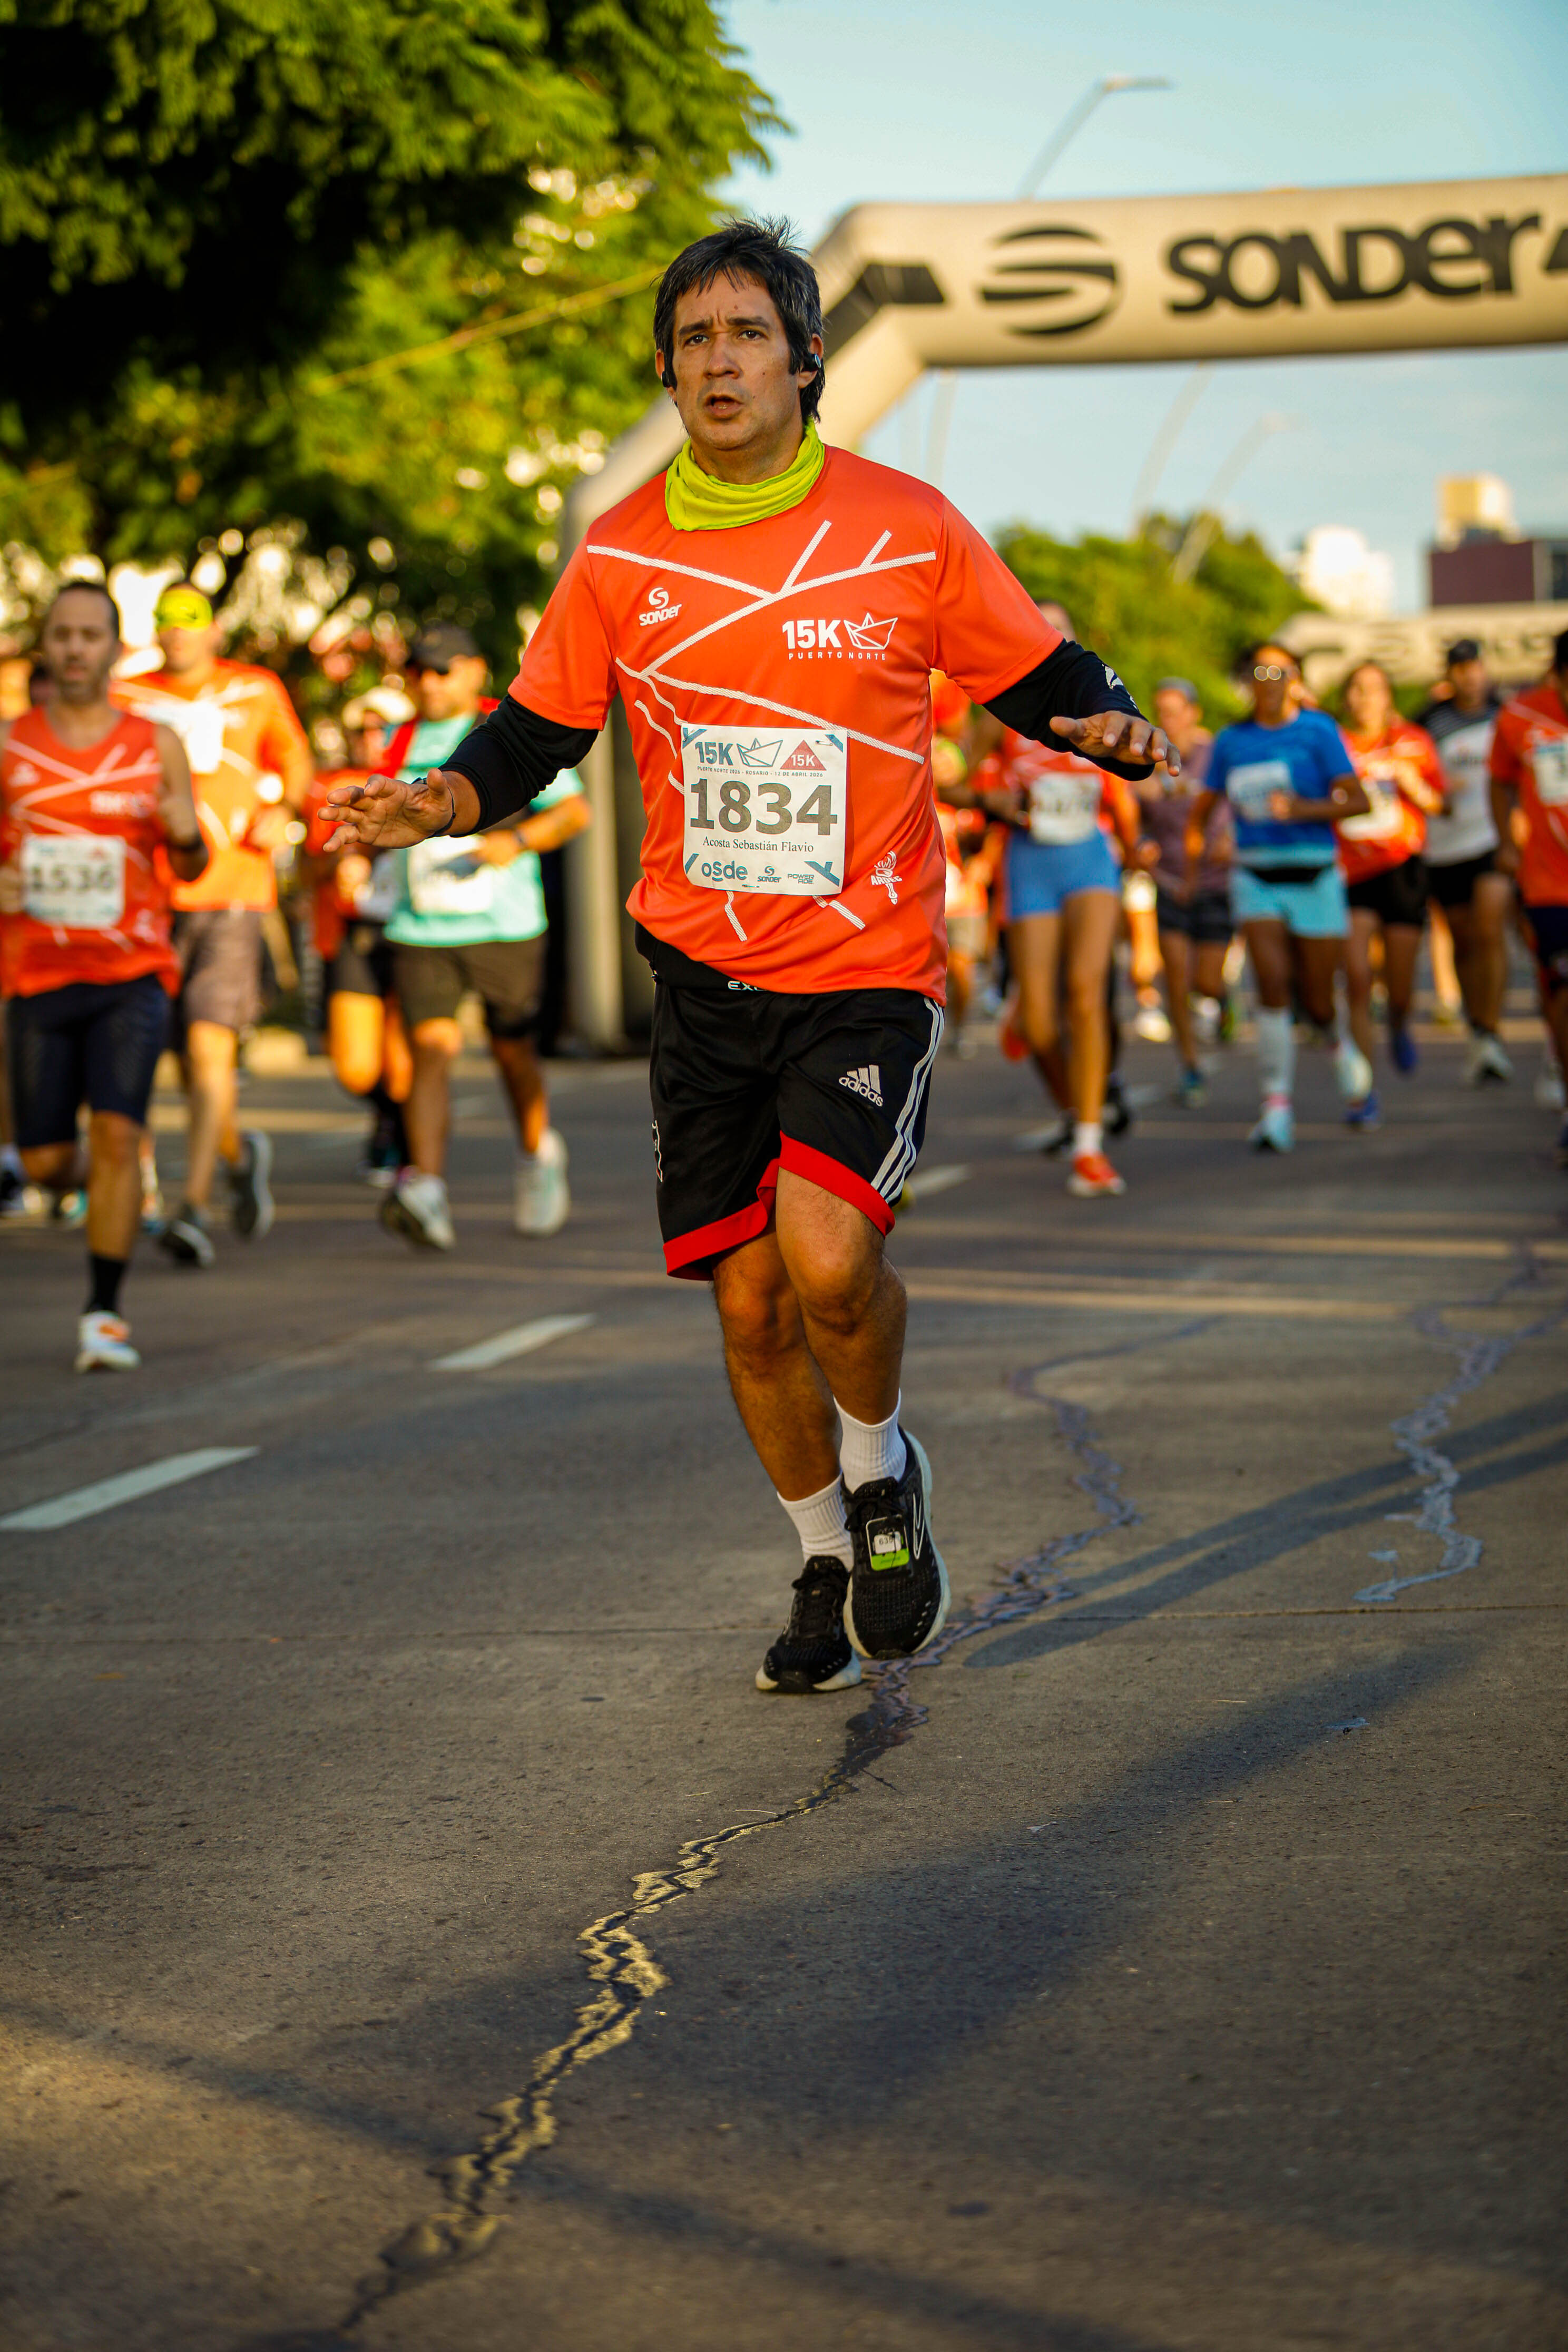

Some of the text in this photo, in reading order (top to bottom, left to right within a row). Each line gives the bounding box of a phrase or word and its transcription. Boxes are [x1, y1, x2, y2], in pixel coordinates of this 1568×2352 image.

[782, 619, 842, 649] 15K
[788, 651, 885, 660] PUERTO NORTE
[695, 741, 733, 766] 15K
[791, 754, 815, 767] 15K
[690, 778, 838, 836] 1834
[703, 836, 814, 852] Acosta Sebastián Flavio
[701, 860, 748, 880] osde
[839, 1076, 883, 1106] adidas
